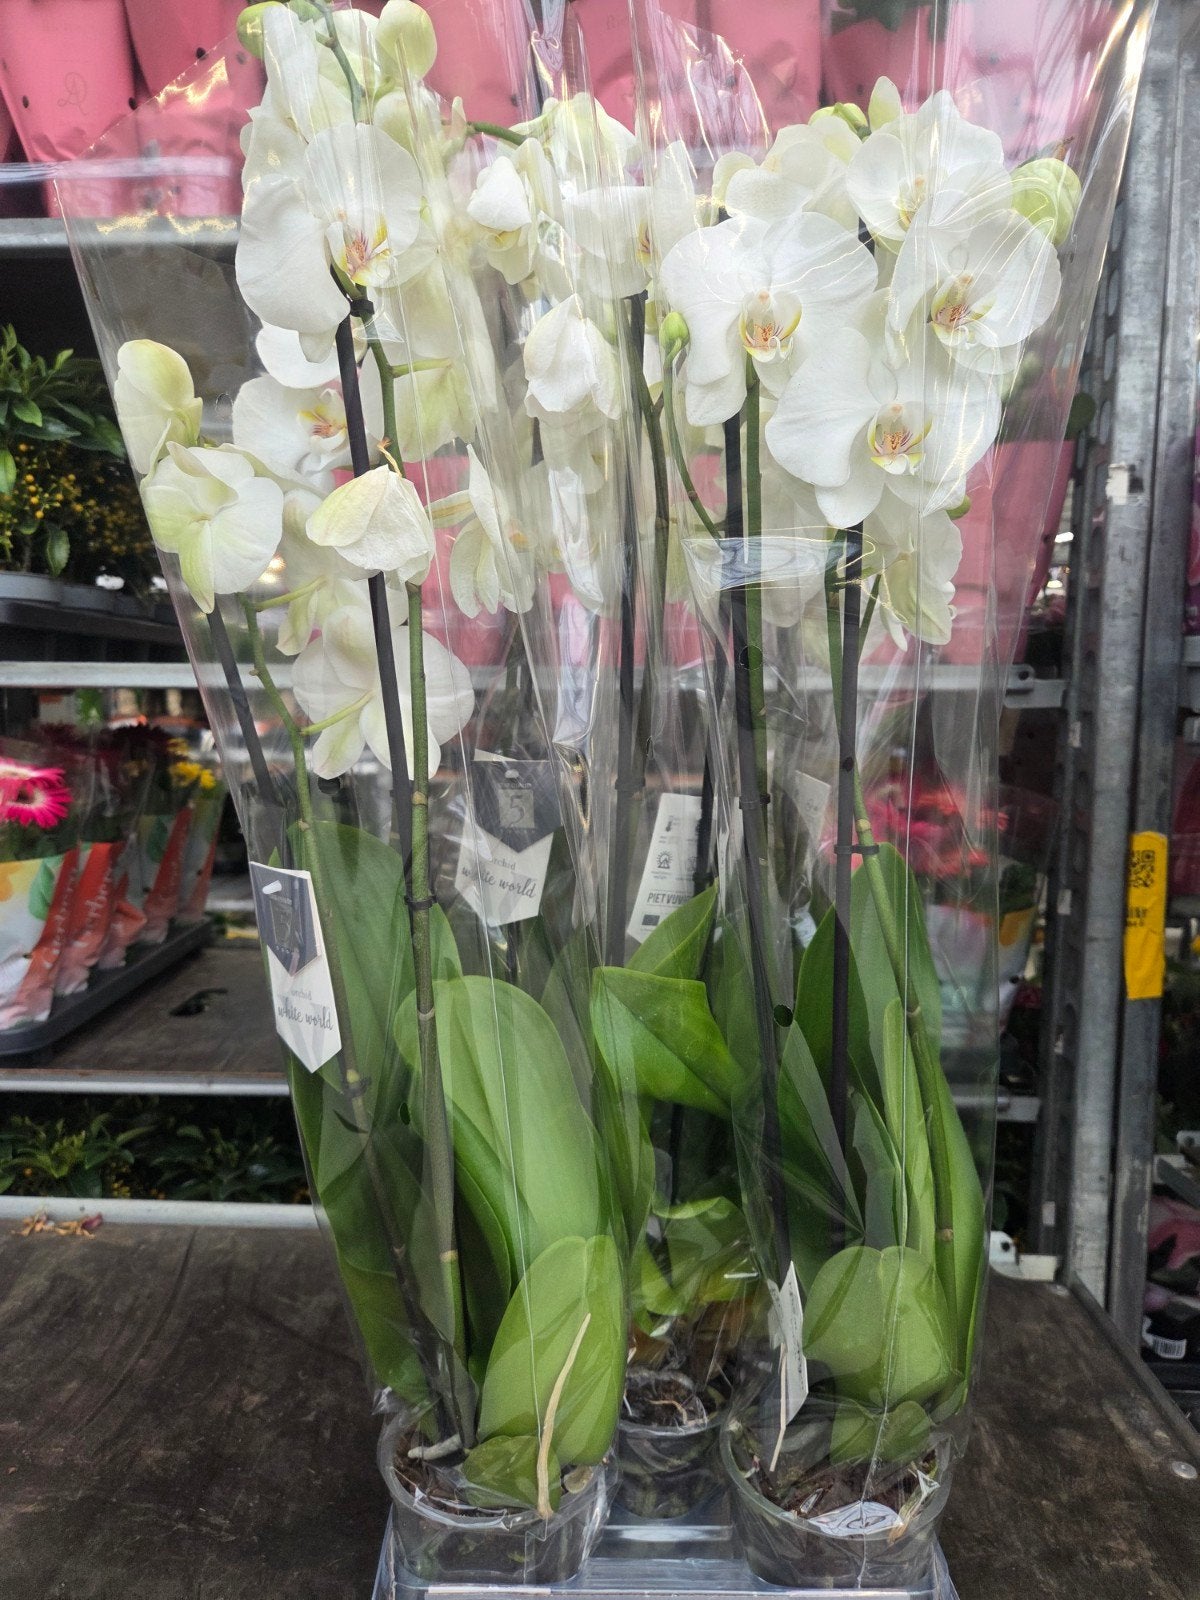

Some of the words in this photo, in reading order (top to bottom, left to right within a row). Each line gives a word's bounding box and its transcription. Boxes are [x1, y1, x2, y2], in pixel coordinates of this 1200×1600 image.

[499, 878, 536, 898] world
[647, 892, 666, 904] PIET
[278, 999, 303, 1022] white
[305, 1006, 333, 1030] world
